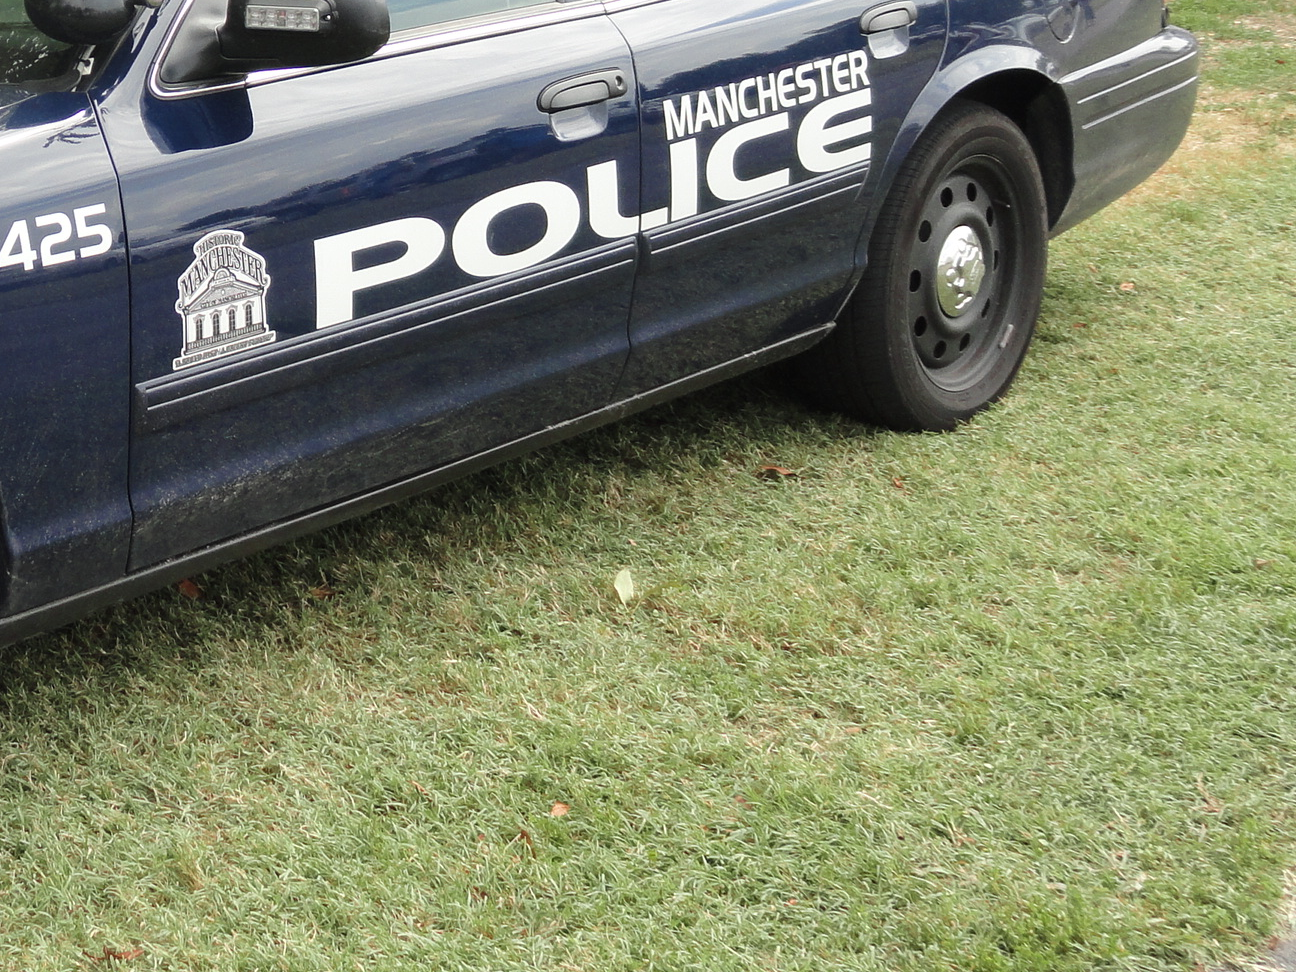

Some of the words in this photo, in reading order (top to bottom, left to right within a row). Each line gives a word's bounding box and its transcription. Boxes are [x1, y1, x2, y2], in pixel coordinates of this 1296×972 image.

[663, 49, 870, 142] MANCHESTER
[197, 234, 242, 256] HISTORIC
[313, 88, 872, 330] POLICE
[178, 246, 268, 309] MANCHESTER
